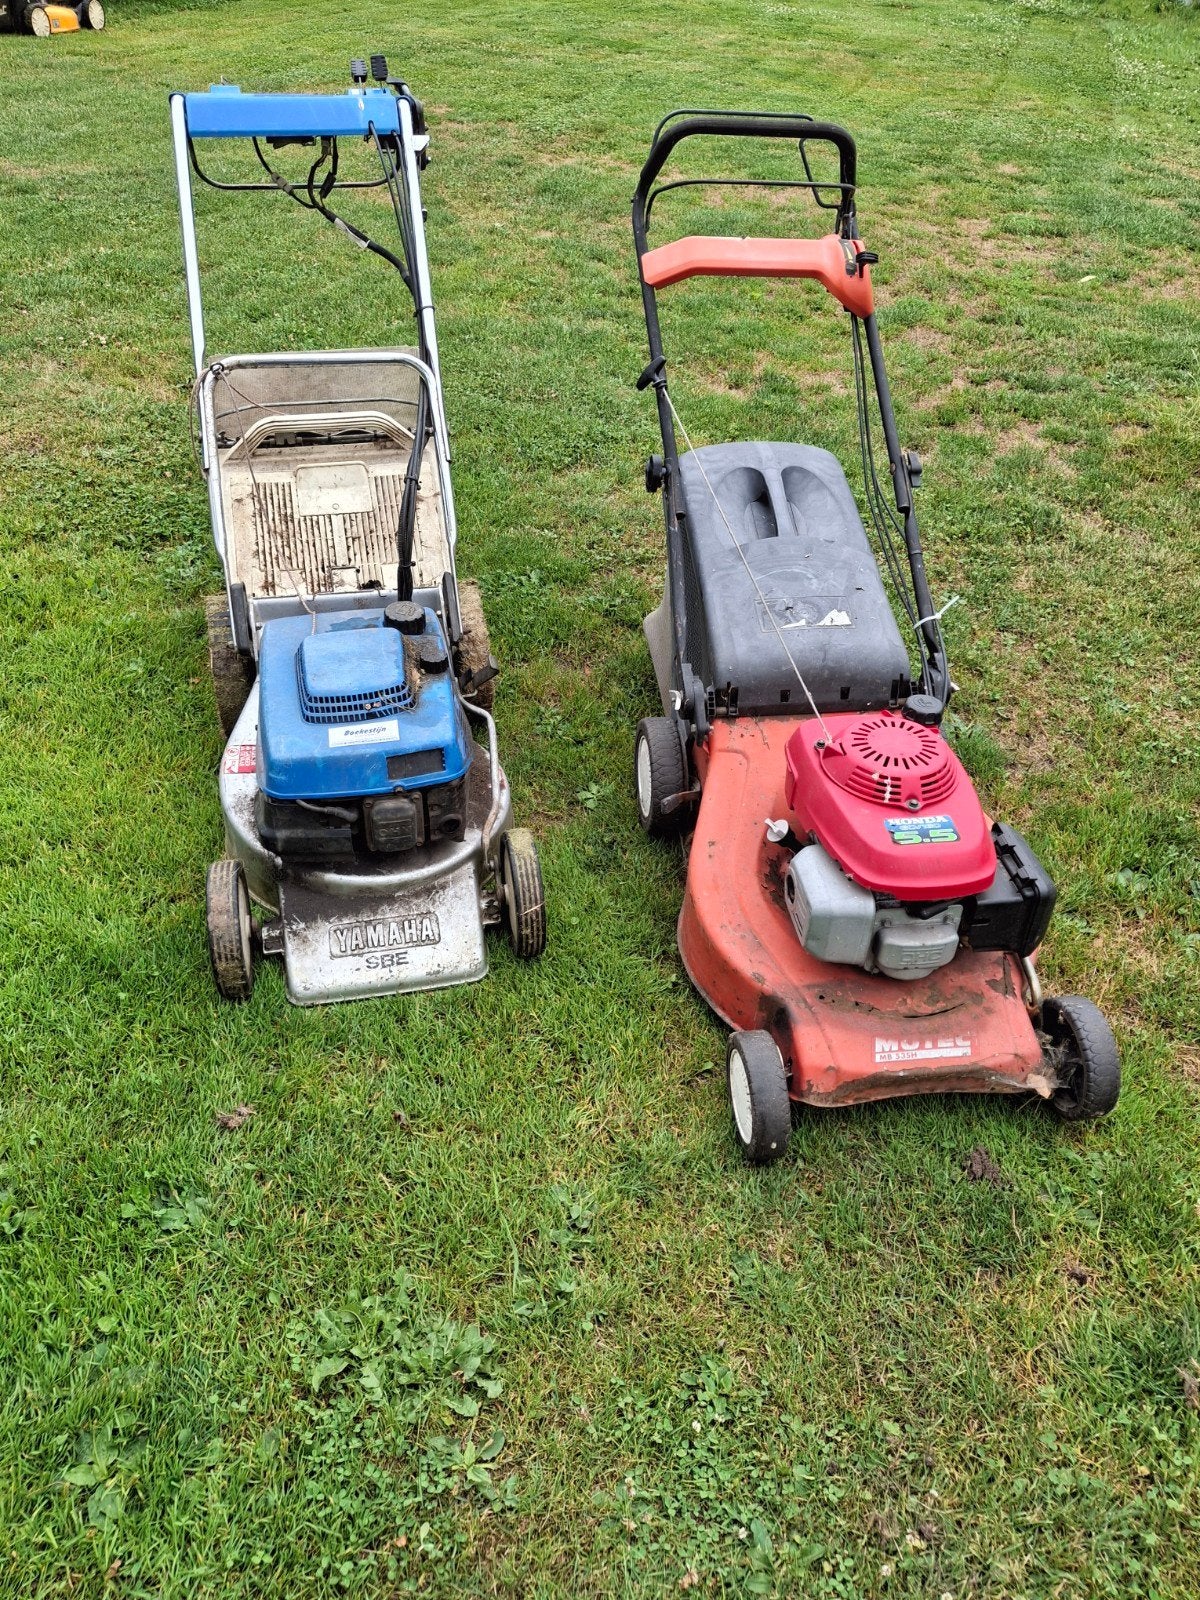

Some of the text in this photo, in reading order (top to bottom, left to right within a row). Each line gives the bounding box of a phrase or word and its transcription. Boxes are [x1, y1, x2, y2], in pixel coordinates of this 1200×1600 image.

[344, 726, 387, 736] Boekestijn
[886, 815, 949, 825] HONDA
[893, 828, 958, 845] 5.5
[335, 917, 435, 952] YAMAHA
[365, 951, 409, 969] SBE
